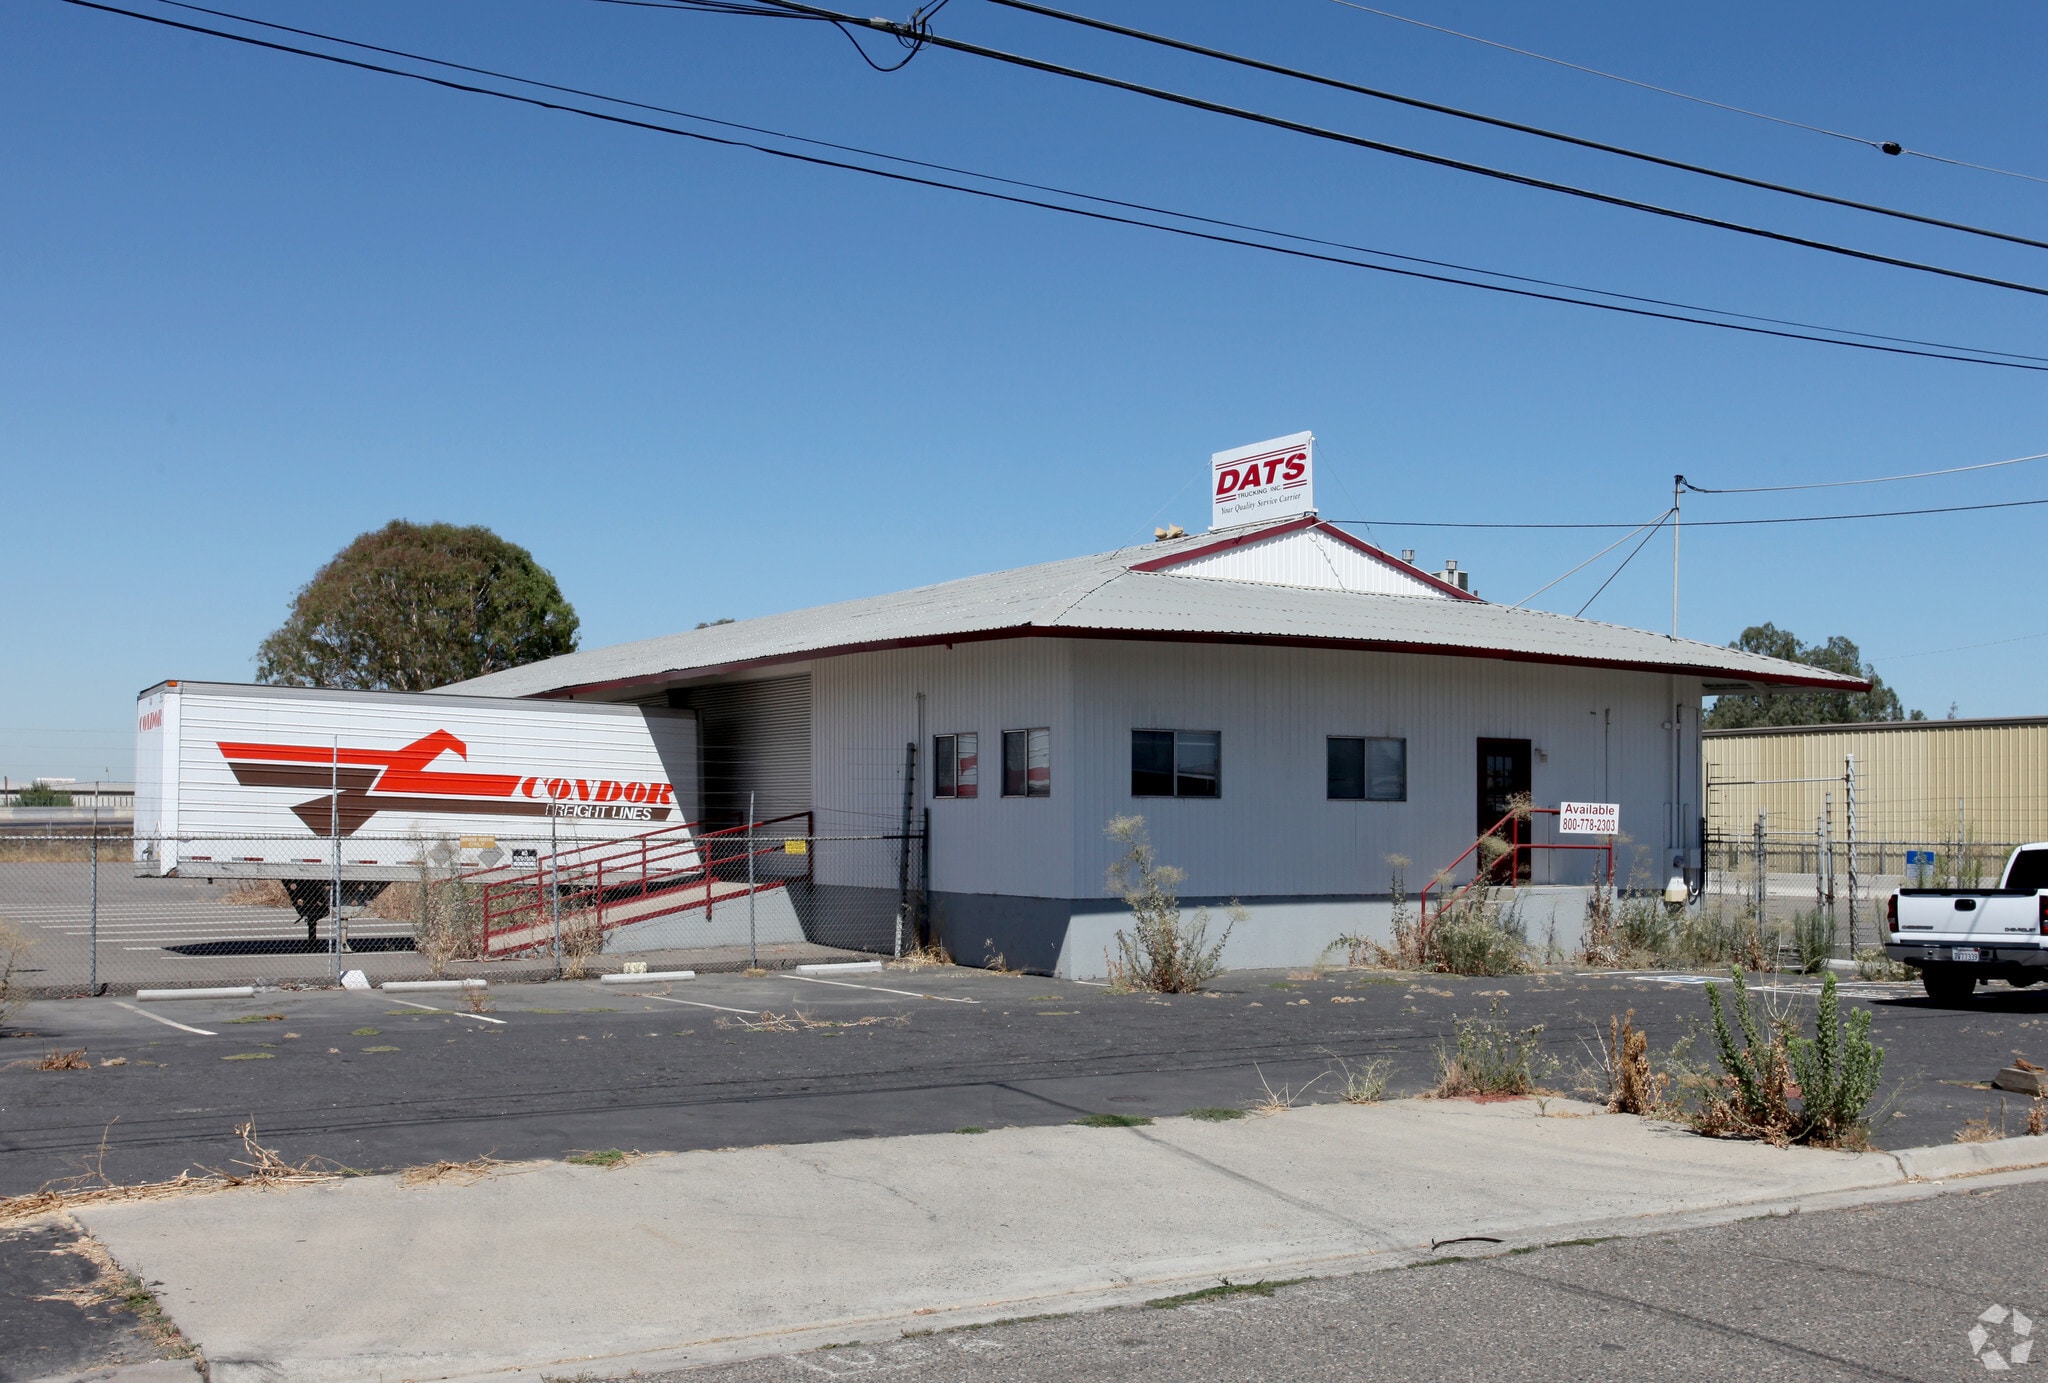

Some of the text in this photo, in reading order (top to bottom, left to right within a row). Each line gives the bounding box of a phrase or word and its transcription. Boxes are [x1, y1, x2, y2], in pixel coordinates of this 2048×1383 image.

[1215, 452, 1307, 496] DATS
[1237, 487, 1268, 499] TRUCKING
[1221, 492, 1301, 515] Your Quality Service Carrier
[521, 776, 674, 805] CONDOR
[611, 806, 653, 821] LINES
[1564, 803, 1615, 816] Available
[1562, 817, 1616, 832] 800-778-2303
